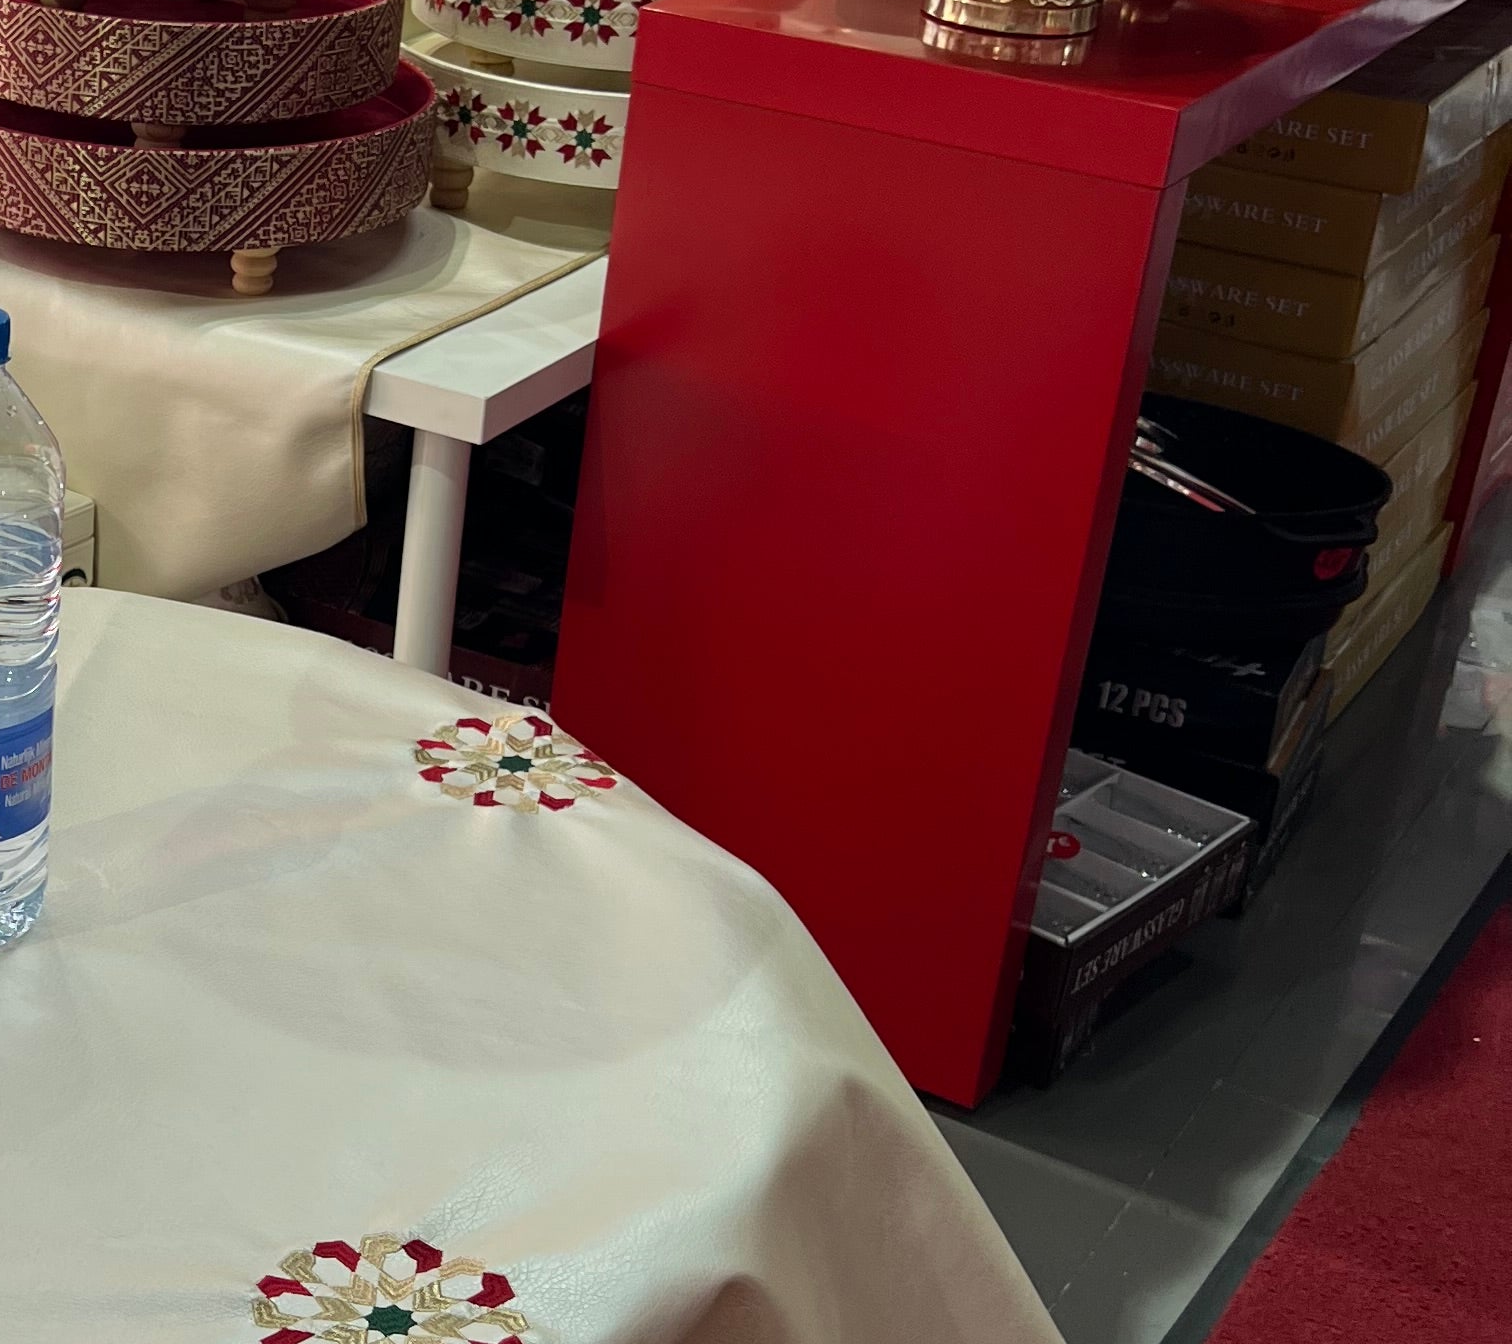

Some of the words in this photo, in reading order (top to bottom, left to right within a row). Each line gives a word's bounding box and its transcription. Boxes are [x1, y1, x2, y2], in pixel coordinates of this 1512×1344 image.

[1327, 127, 1375, 150] SET
[1282, 211, 1328, 234] SET
[1265, 295, 1311, 318] SET
[1259, 378, 1305, 401] SET
[1097, 679, 1129, 715] 12
[1131, 687, 1188, 729] PCS
